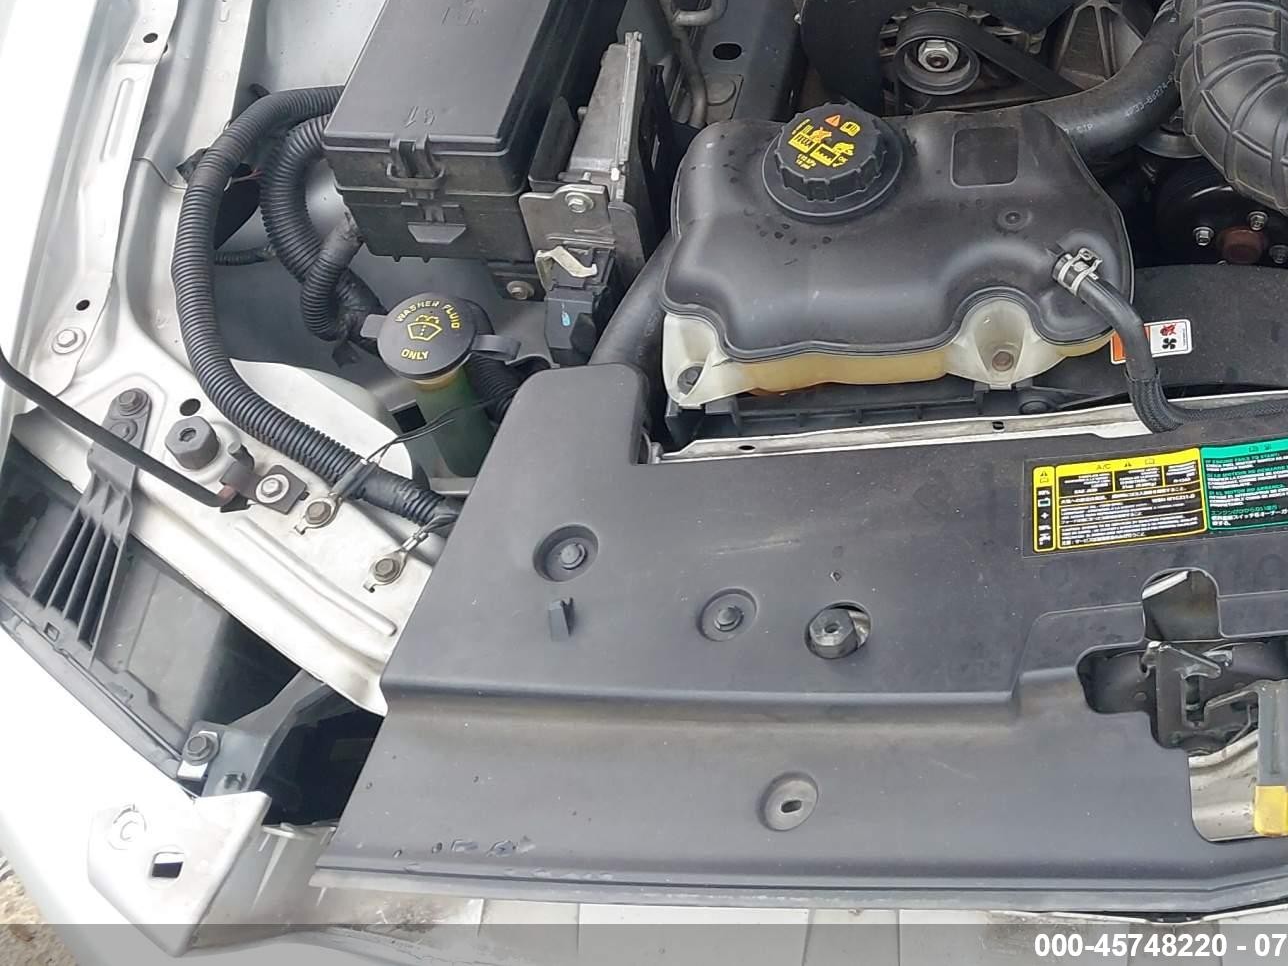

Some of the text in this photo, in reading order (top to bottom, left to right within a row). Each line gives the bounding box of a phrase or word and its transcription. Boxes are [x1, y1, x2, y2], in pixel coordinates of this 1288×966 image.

[395, 300, 462, 330] WASHER FLUID
[400, 348, 430, 361] ONLY
